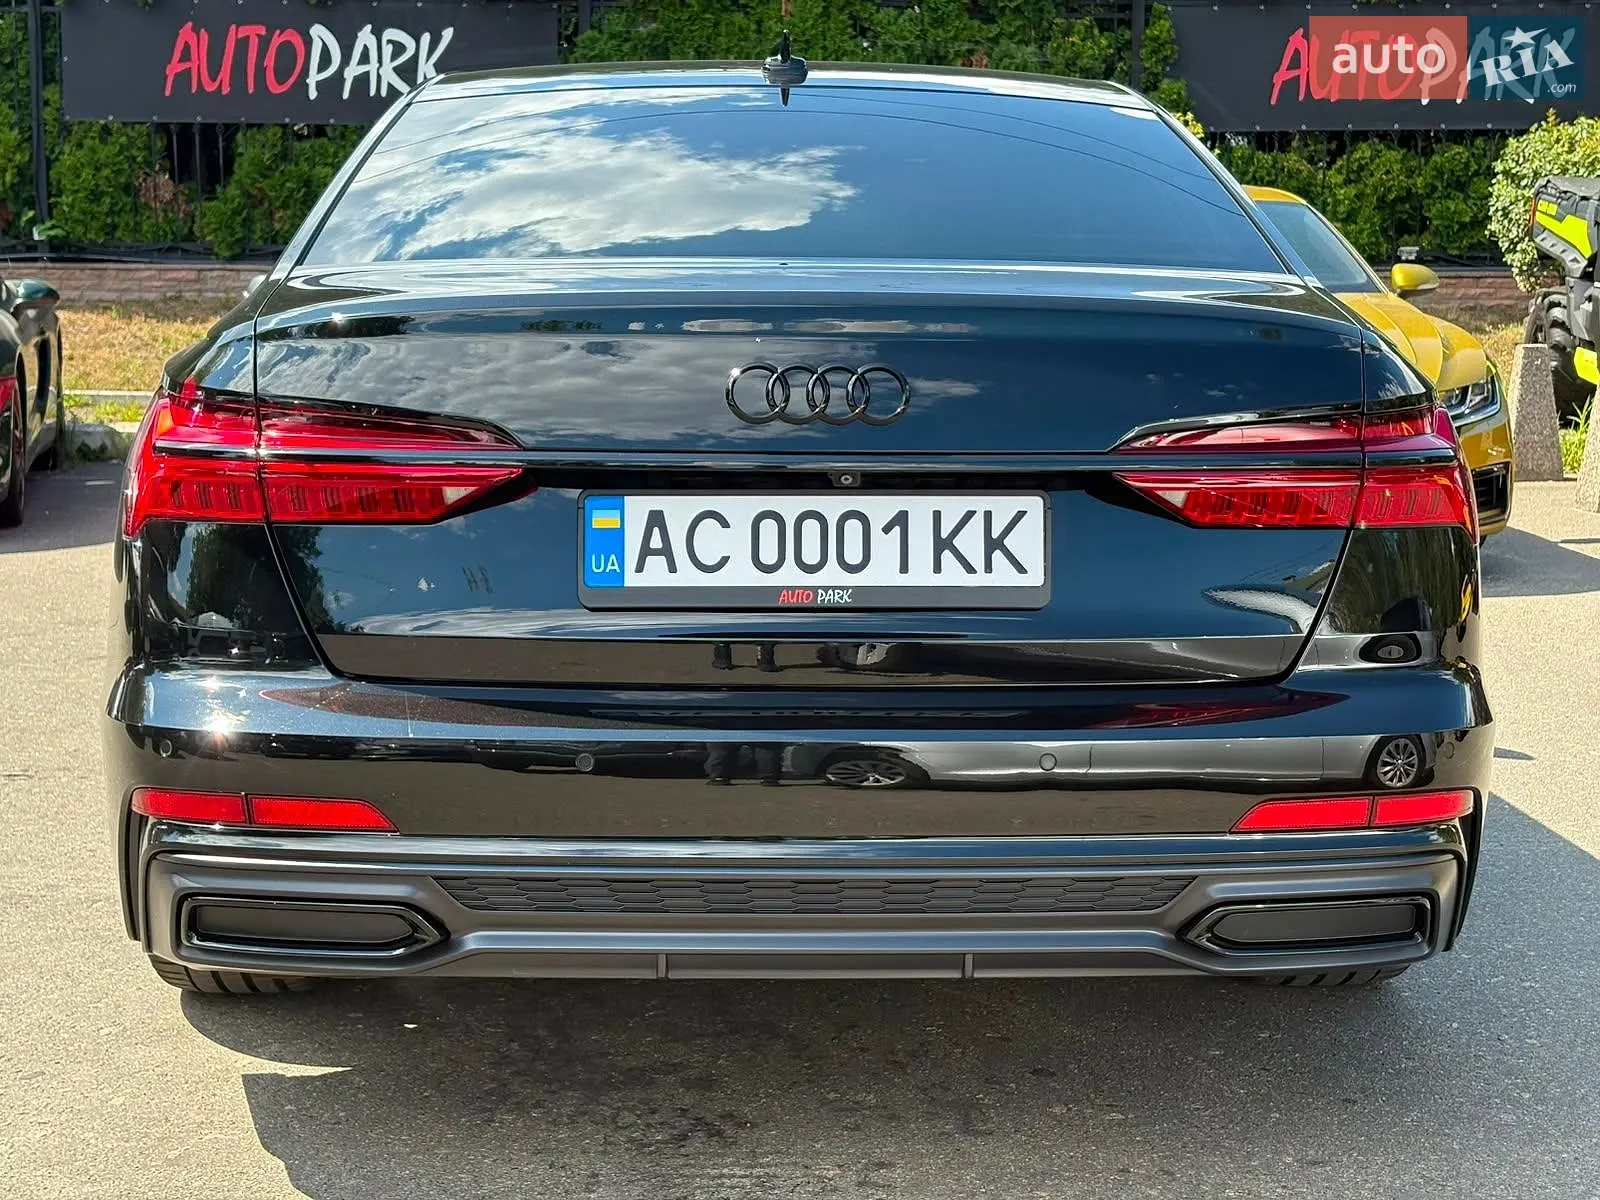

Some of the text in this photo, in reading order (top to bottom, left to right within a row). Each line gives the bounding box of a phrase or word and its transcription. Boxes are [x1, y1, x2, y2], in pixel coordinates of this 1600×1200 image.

[634, 509, 1029, 574] AC 0001 KK
[591, 553, 621, 573] UA
[778, 589, 853, 606] AUTO PARK
